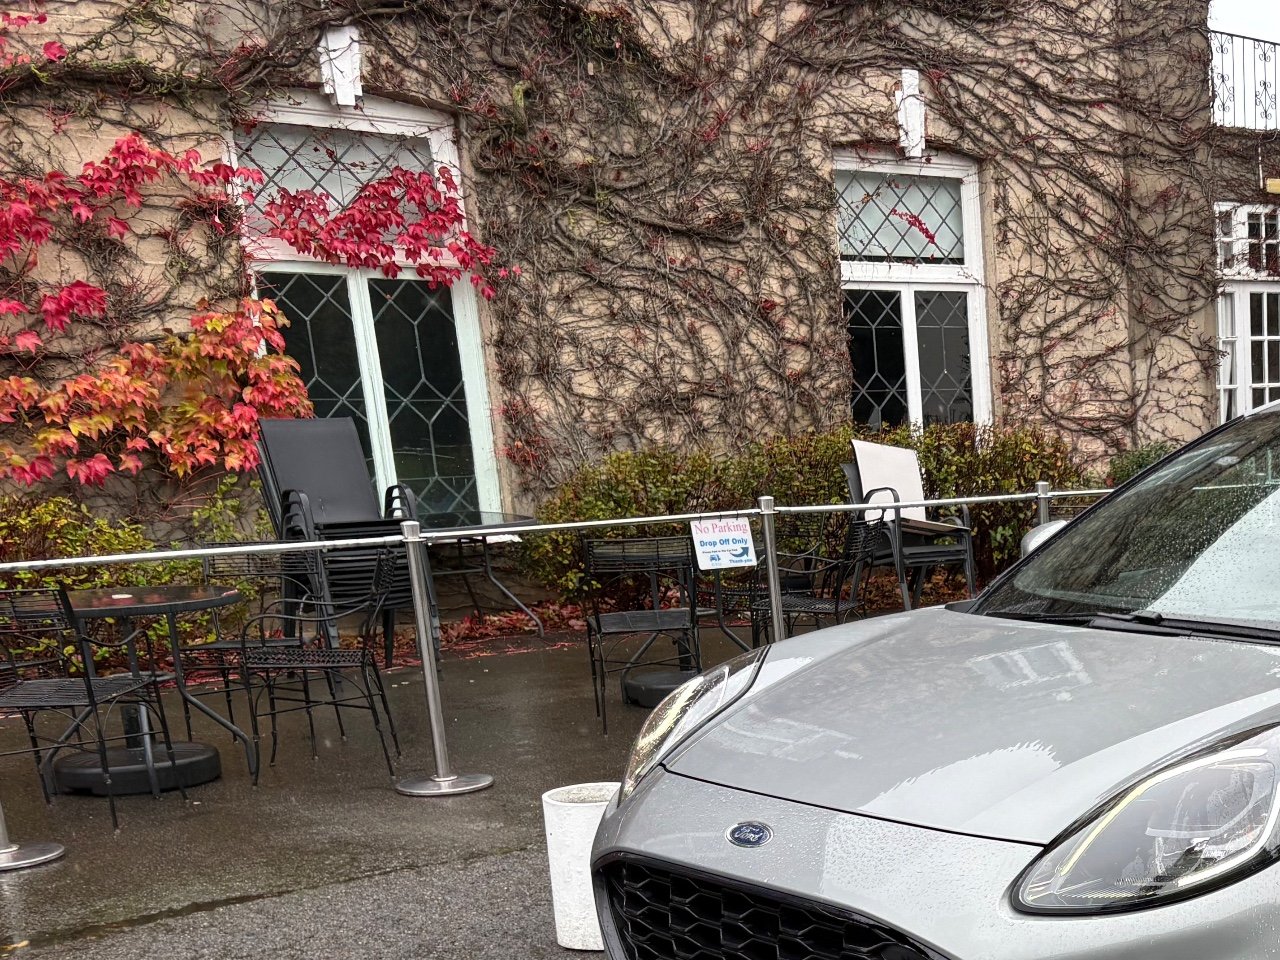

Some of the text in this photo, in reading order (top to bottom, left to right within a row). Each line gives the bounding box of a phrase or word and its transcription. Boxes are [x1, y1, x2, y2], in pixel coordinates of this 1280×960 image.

[694, 521, 749, 534] No Parking
[700, 537, 748, 548] Drop Off Only
